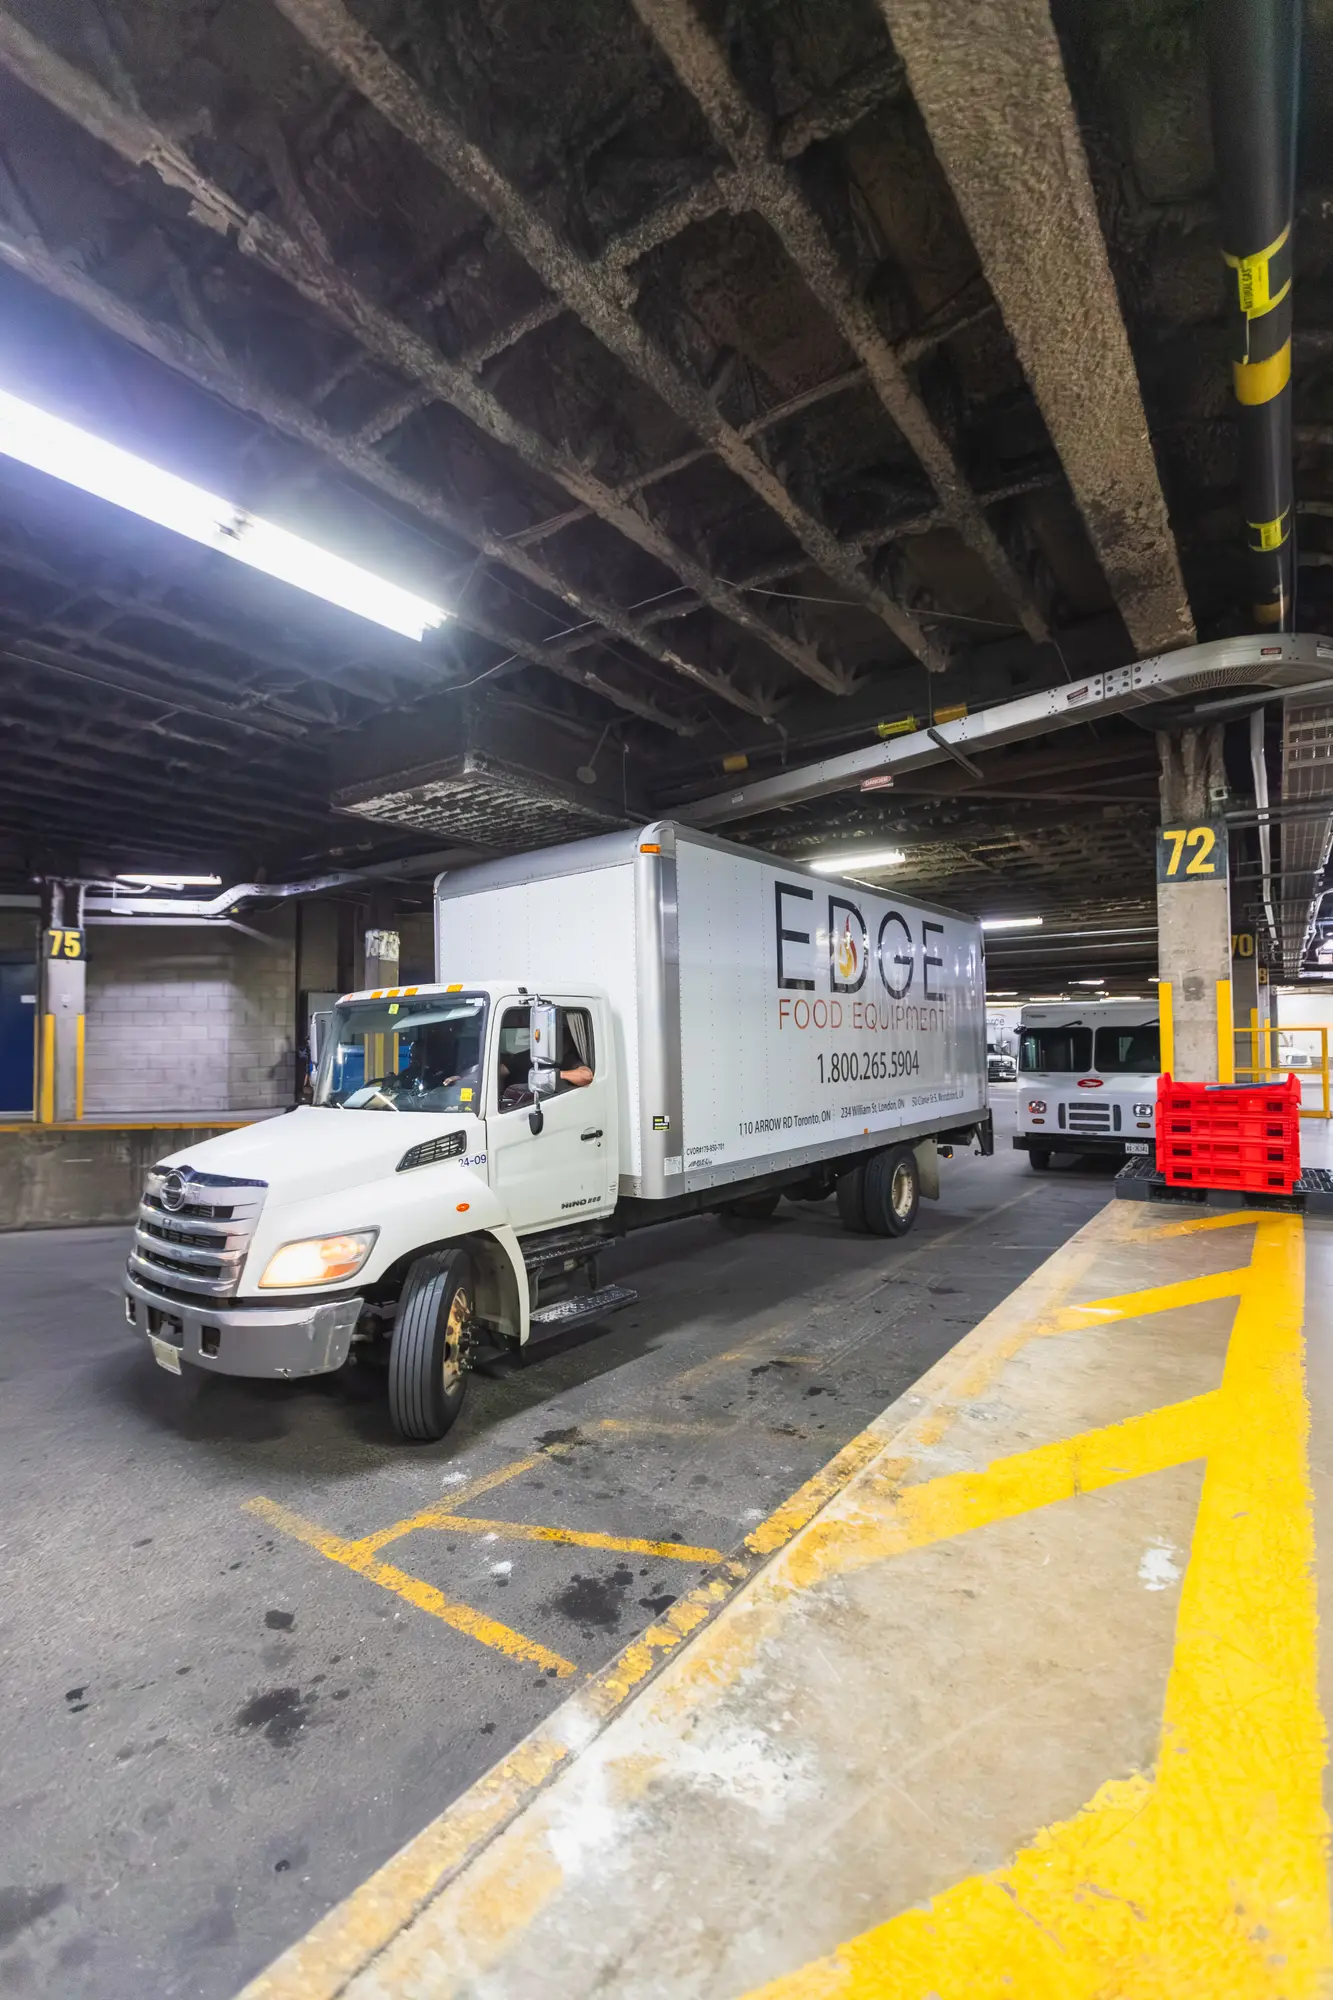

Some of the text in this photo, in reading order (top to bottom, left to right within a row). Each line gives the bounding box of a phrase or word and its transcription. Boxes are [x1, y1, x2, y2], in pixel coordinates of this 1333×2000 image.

[1241, 268, 1252, 281] GAS
[1163, 826, 1216, 876] 72
[48, 930, 81, 958] 75
[775, 881, 947, 1002] EDGE
[779, 999, 945, 1034] FOOD EQUIPMENT
[817, 1050, 920, 1084] 1.800.265.5904
[739, 1109, 831, 1135] 110 ARROW RD Toronto, ON
[841, 1106, 852, 1119] 234
[852, 1102, 871, 1117] William
[879, 1099, 897, 1113] London,
[897, 1098, 905, 1109] ON
[458, 1154, 487, 1167] 24-09
[561, 1198, 587, 1209] HINO
